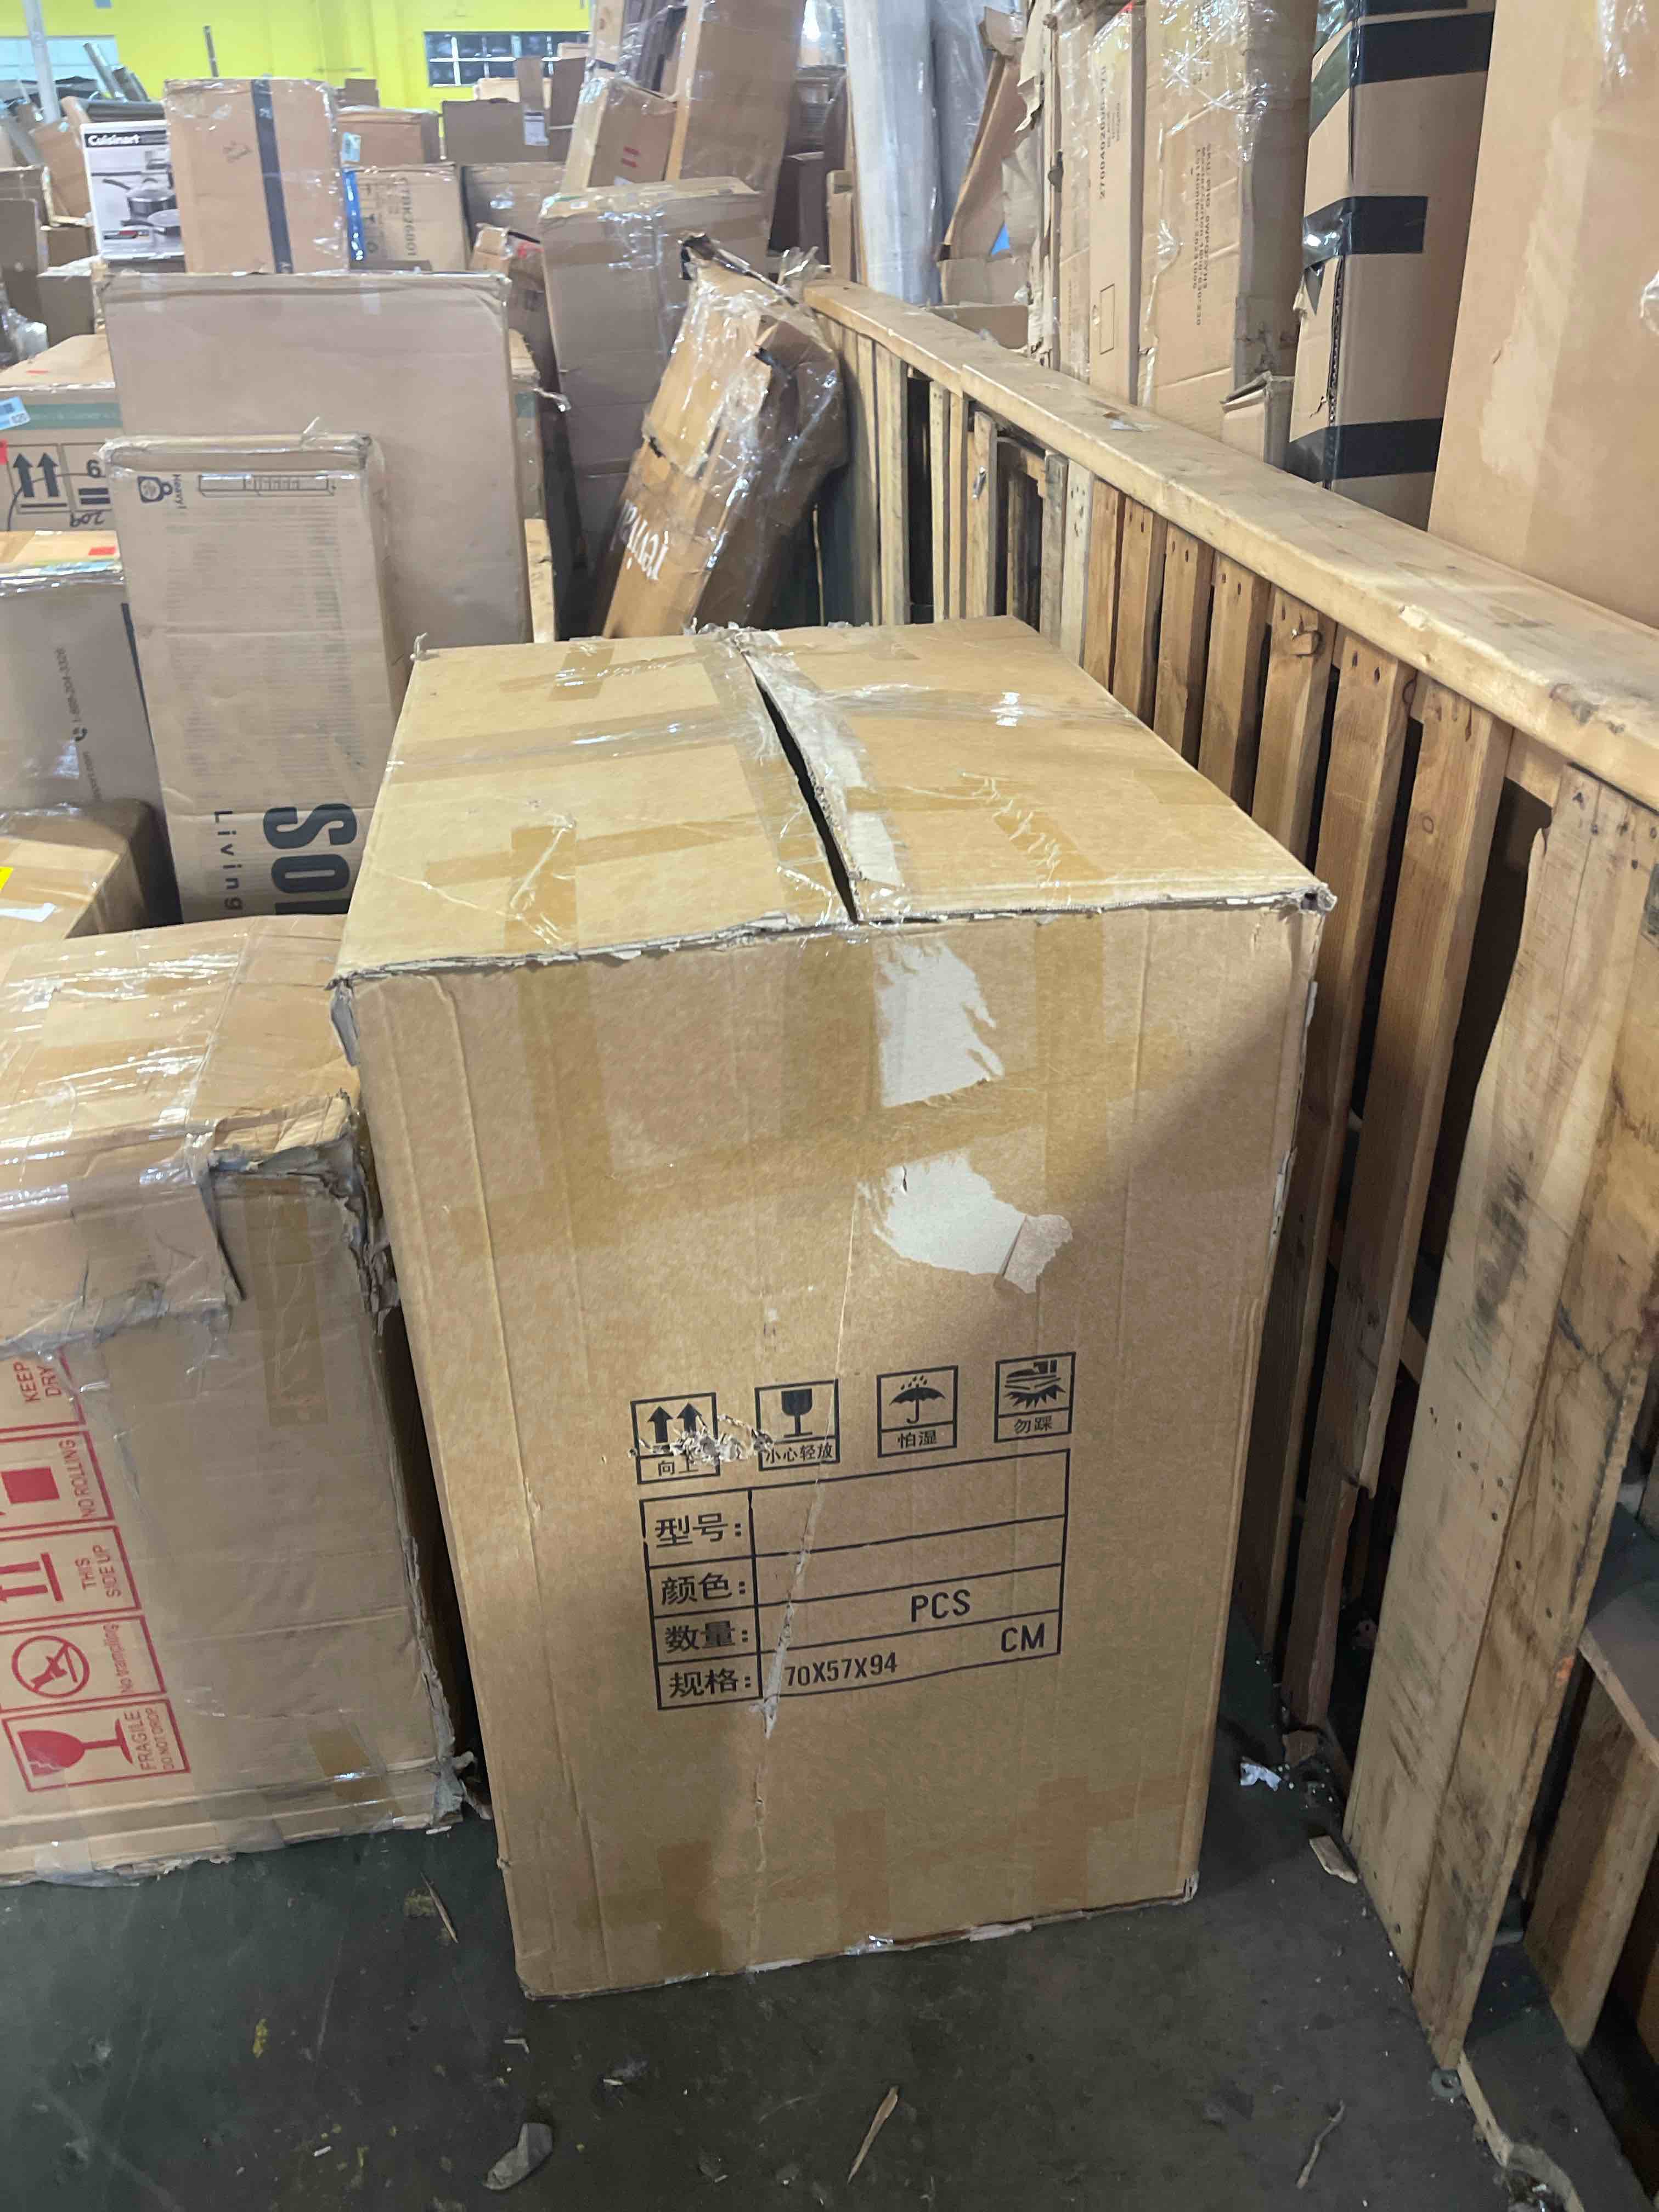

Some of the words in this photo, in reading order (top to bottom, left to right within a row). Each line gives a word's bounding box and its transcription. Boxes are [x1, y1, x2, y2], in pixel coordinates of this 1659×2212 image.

[214, 810, 243, 910] Living
[14, 1361, 40, 1402] KEEP
[37, 1364, 61, 1397] DRY
[1014, 1415, 1052, 1434] 勿踩
[765, 1442, 834, 1464] 小心轻放
[897, 1430, 936, 1449] 怕湿
[59, 1439, 89, 1497] ROLLING
[658, 1451, 699, 1476] 向上
[78, 1498, 95, 1518] NO
[93, 1544, 110, 1563] UP
[75, 1557, 97, 1590] THIS
[99, 1566, 122, 1598] SIDE
[911, 1589, 971, 1622] PCS
[785, 1650, 898, 1687] 70X57X94
[1001, 1622, 1045, 1653] CM
[145, 1707, 164, 1734] DROP
[124, 1710, 157, 1770] FRAGILE
[154, 1736, 171, 1756] NOT
[161, 1757, 174, 1770] DO
